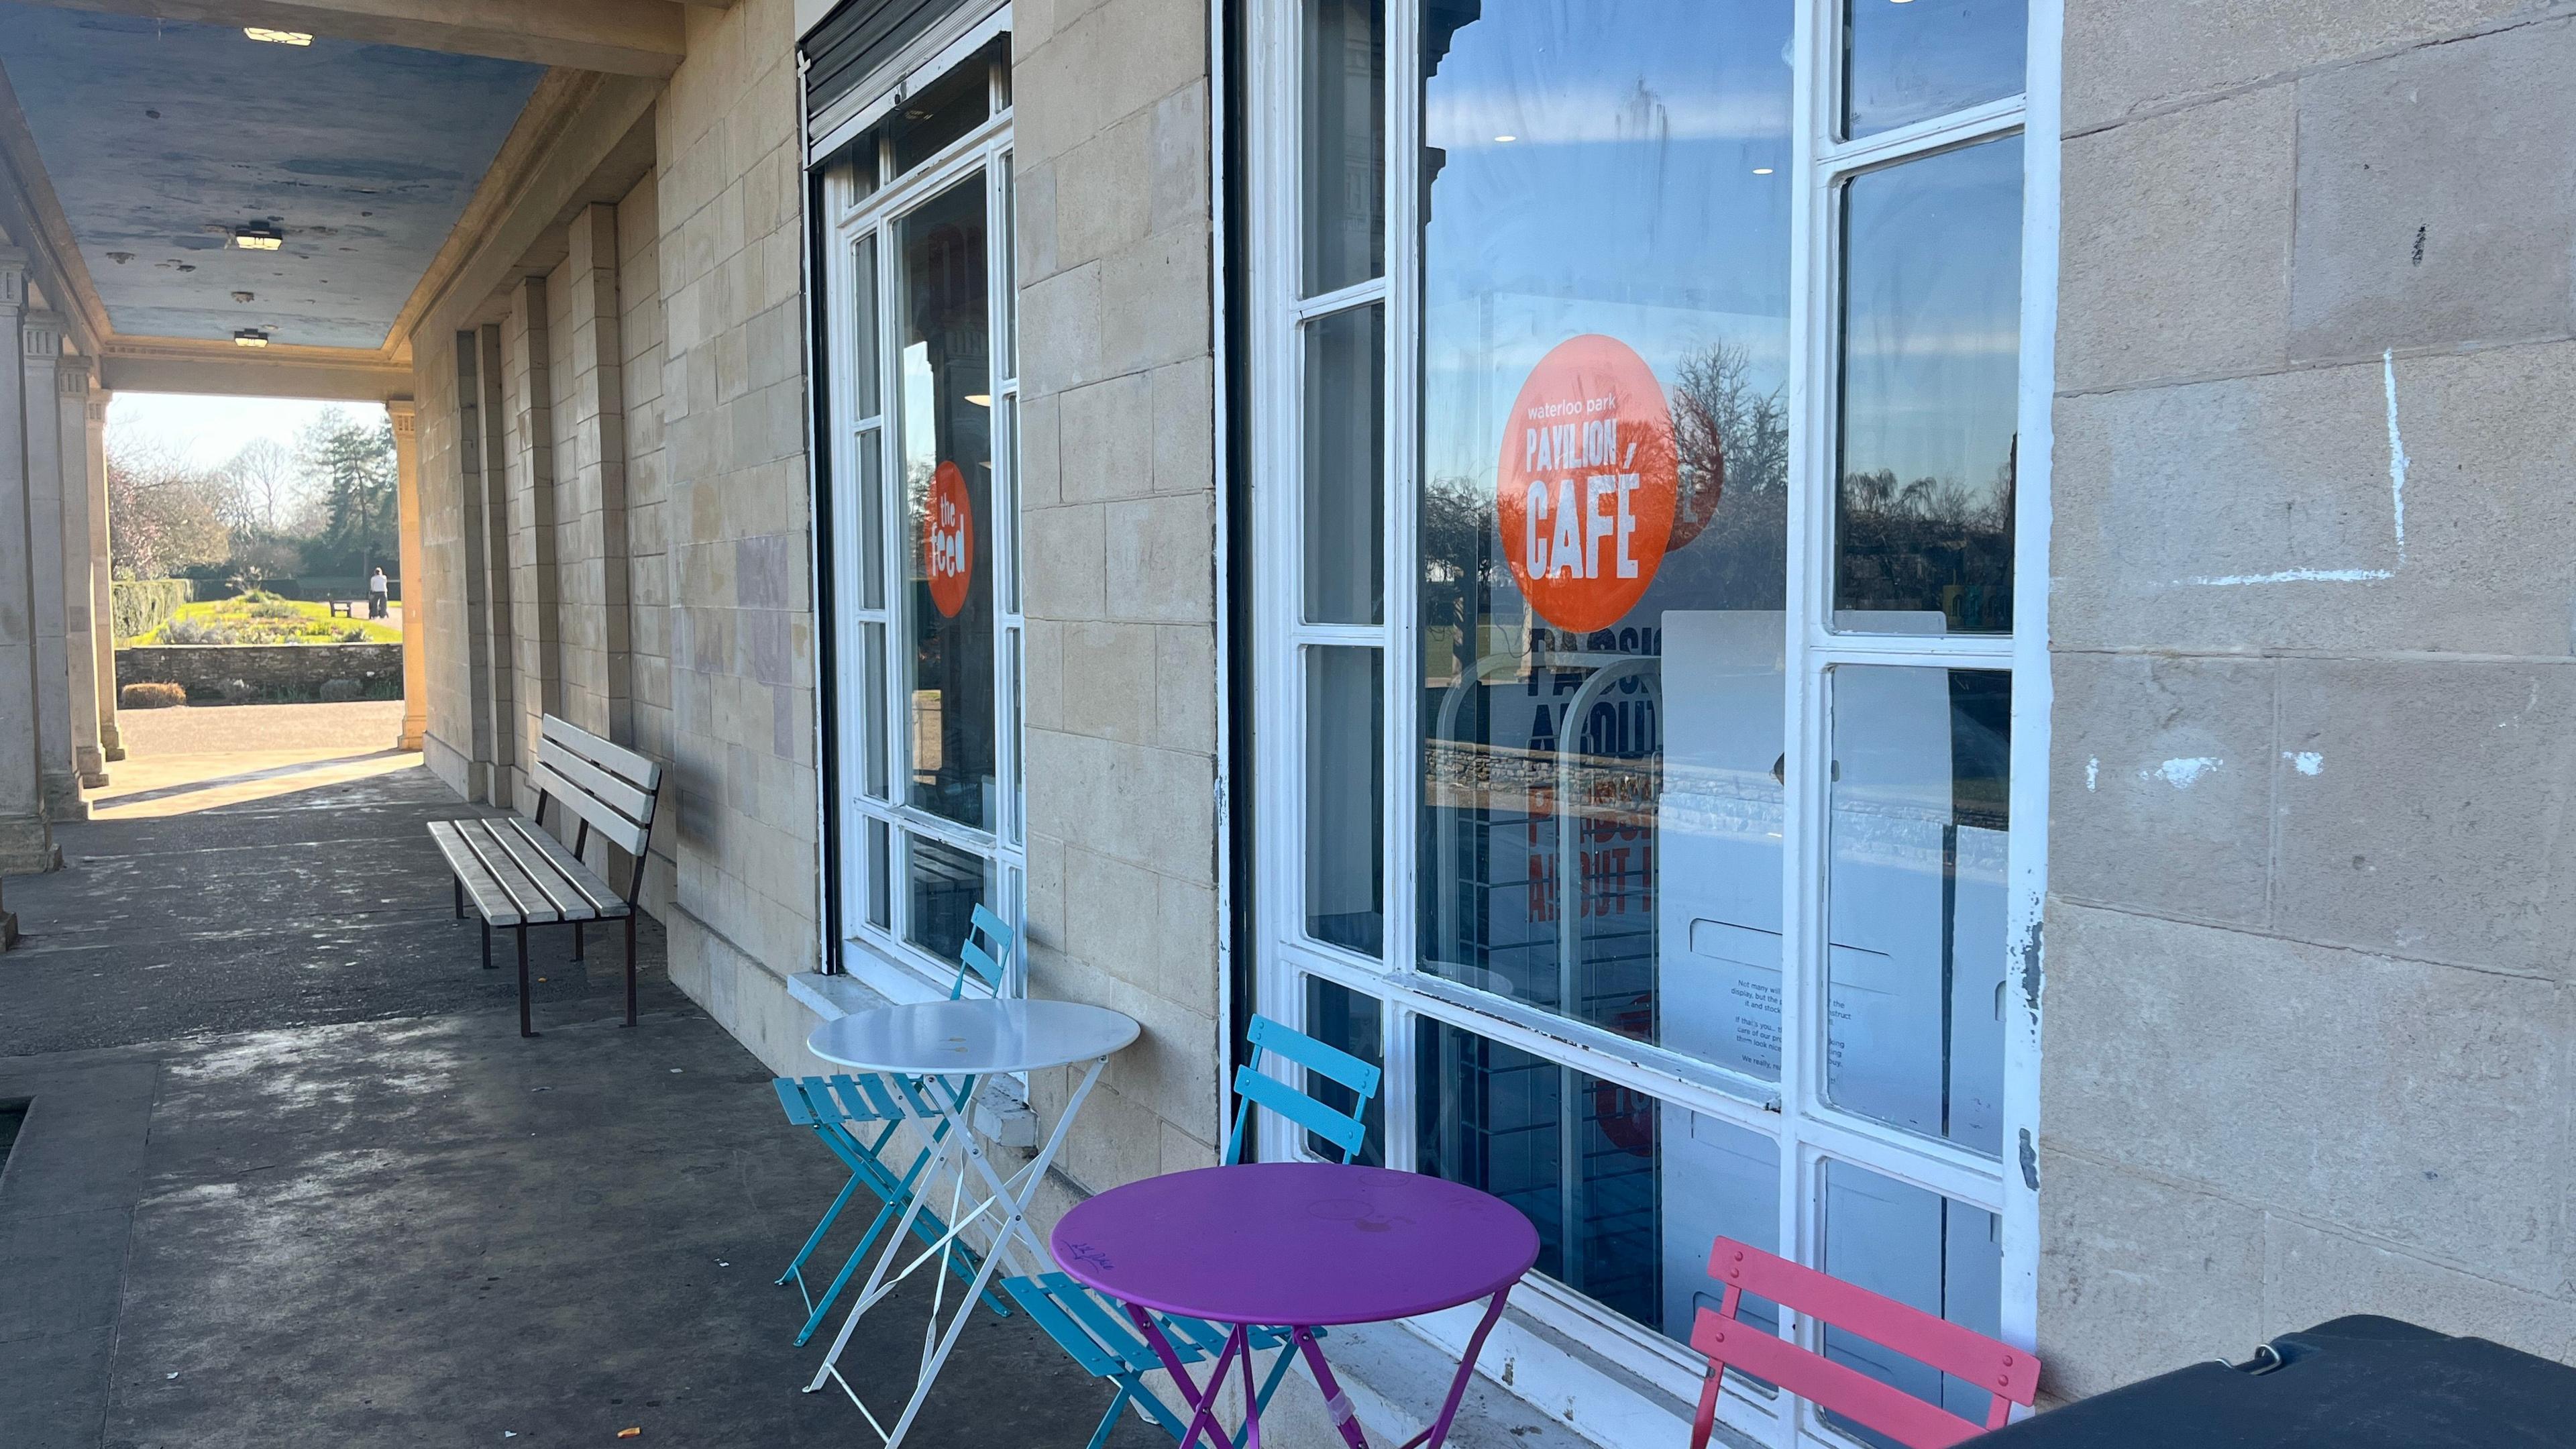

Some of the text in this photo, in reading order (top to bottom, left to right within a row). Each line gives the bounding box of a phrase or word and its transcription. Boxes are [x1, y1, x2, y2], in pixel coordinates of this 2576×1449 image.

[1527, 392, 1617, 421] waterloo park
[1526, 417, 1617, 474] PAVILION
[940, 492, 955, 527] the
[1525, 441, 1640, 580] CAFÉ
[931, 513, 965, 578] feed
[1755, 993, 1766, 1001] but
[1768, 996, 1778, 1004] the
[1741, 1055, 1752, 1063] We
[1754, 1039, 1767, 1048] look
